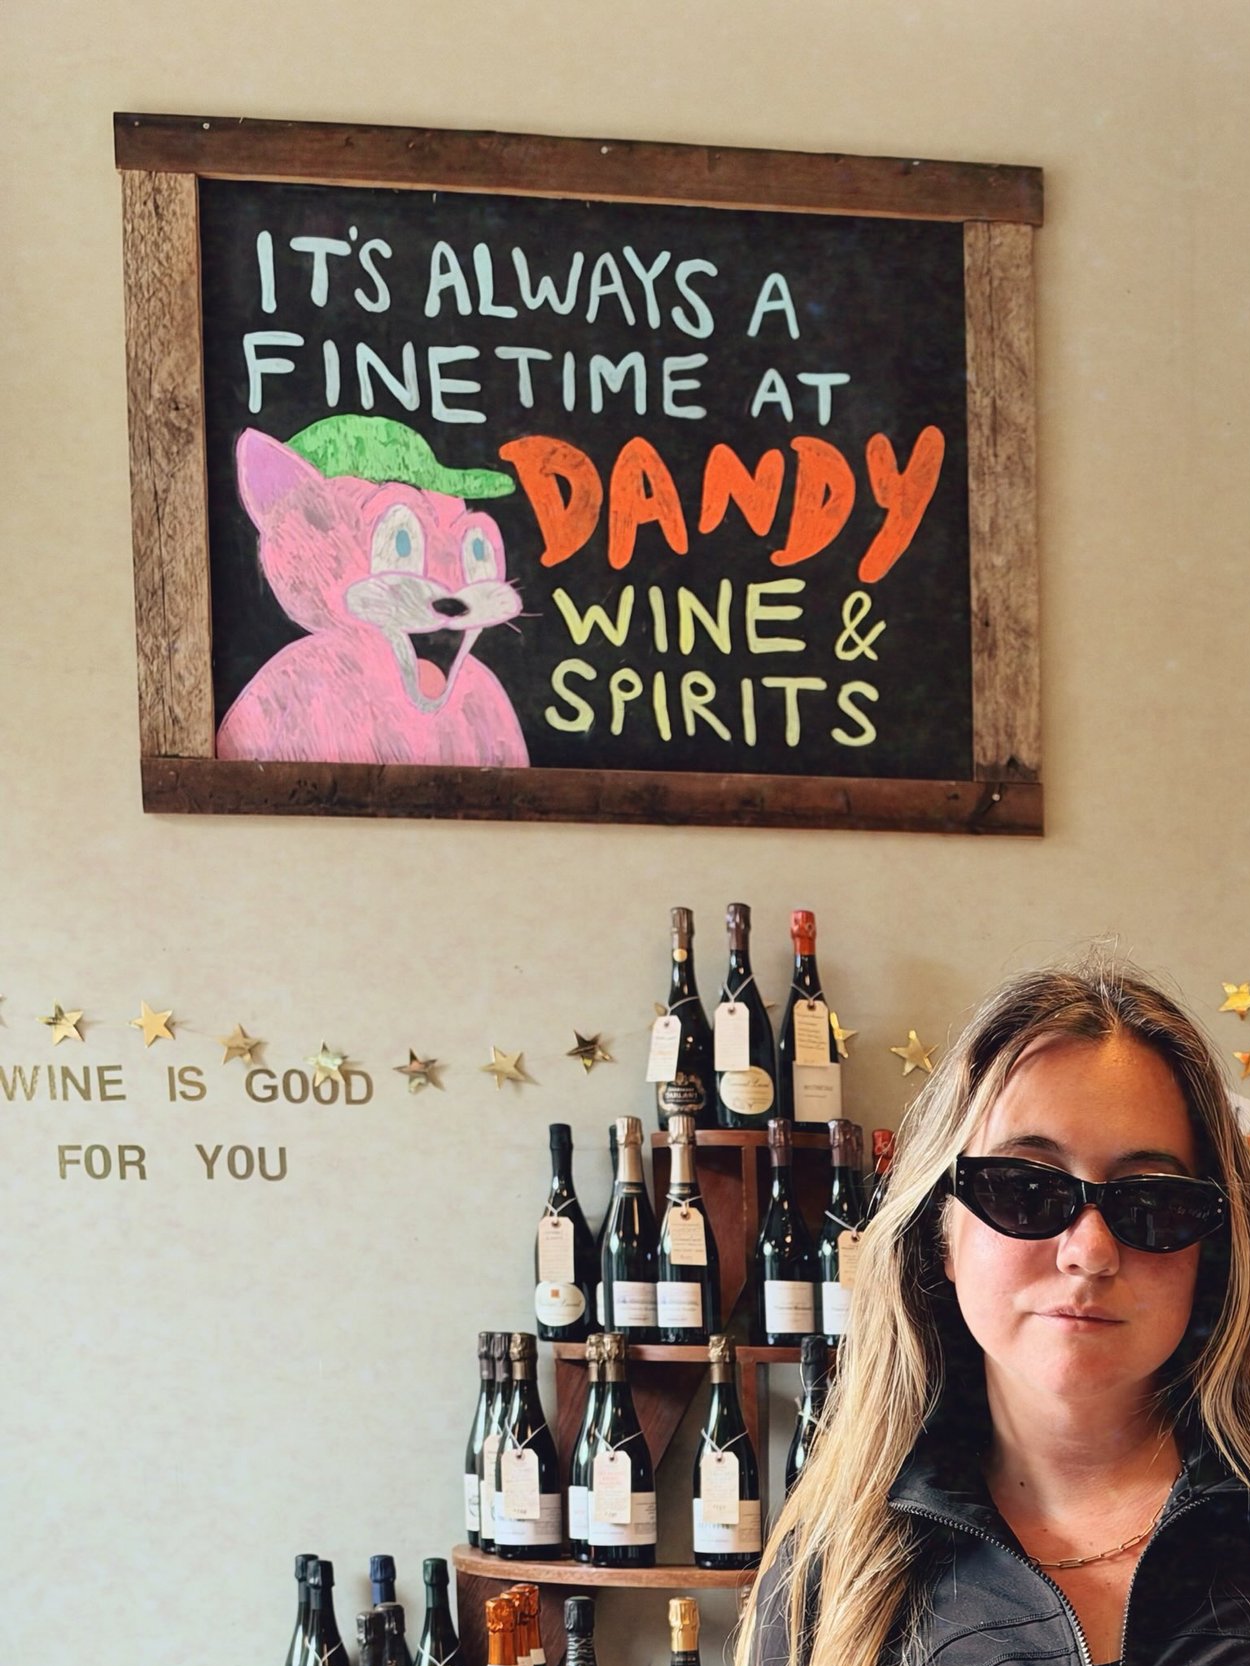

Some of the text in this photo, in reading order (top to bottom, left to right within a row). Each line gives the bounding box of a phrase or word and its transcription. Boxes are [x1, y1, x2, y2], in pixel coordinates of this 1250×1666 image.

[256, 224, 800, 341] IT'S ALWAYS A
[243, 331, 851, 426] FINE TIME AT
[499, 424, 946, 583] DANDY
[552, 578, 885, 663] WINE &
[545, 658, 879, 747] SPIRITS
[0, 1064, 374, 1105] WINE IS GOOD
[58, 1144, 288, 1182] FOR YOU
